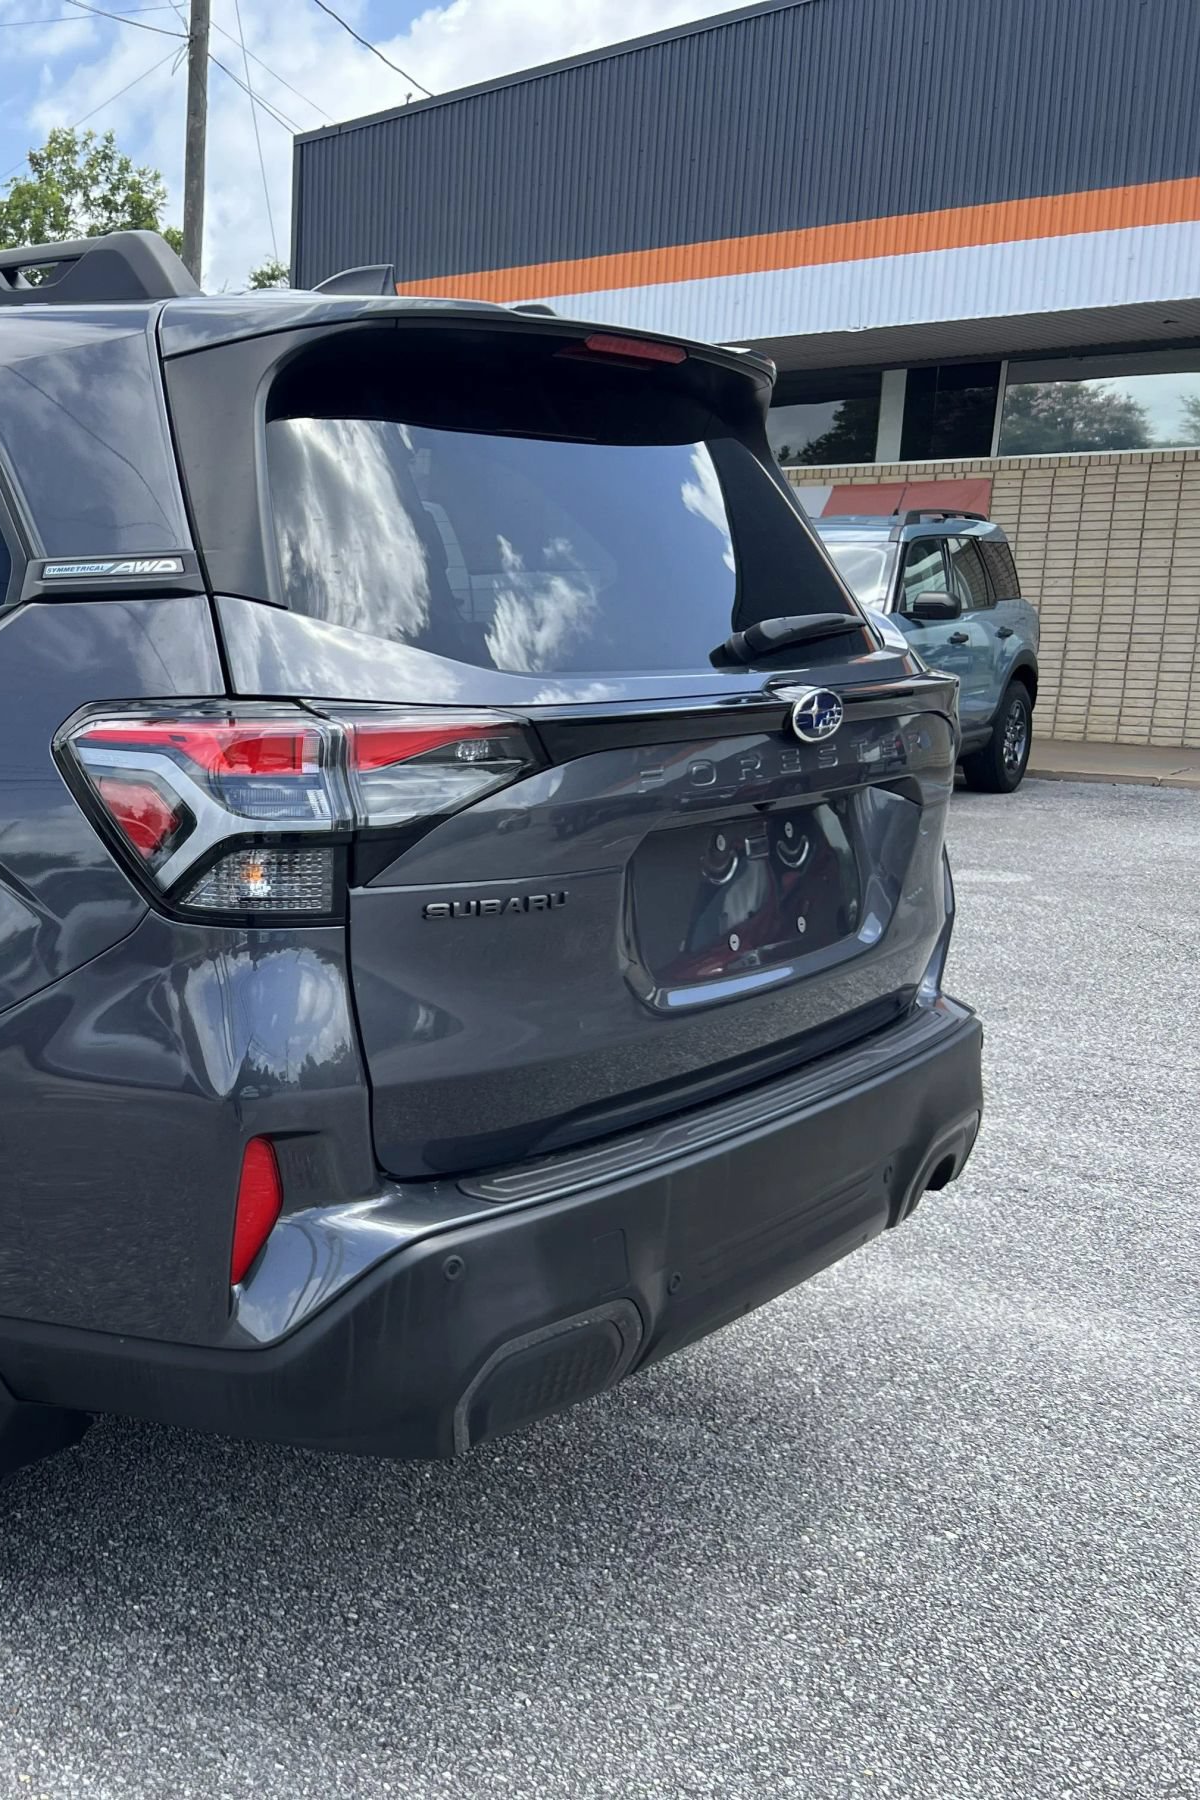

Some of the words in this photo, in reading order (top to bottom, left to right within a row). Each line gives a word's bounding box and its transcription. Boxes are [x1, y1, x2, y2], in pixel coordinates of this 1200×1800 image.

[47, 565, 106, 574] SYMMETRICAL
[110, 560, 179, 574] AWD
[638, 732, 927, 794] FORESTER
[422, 891, 569, 920] SUBARU
